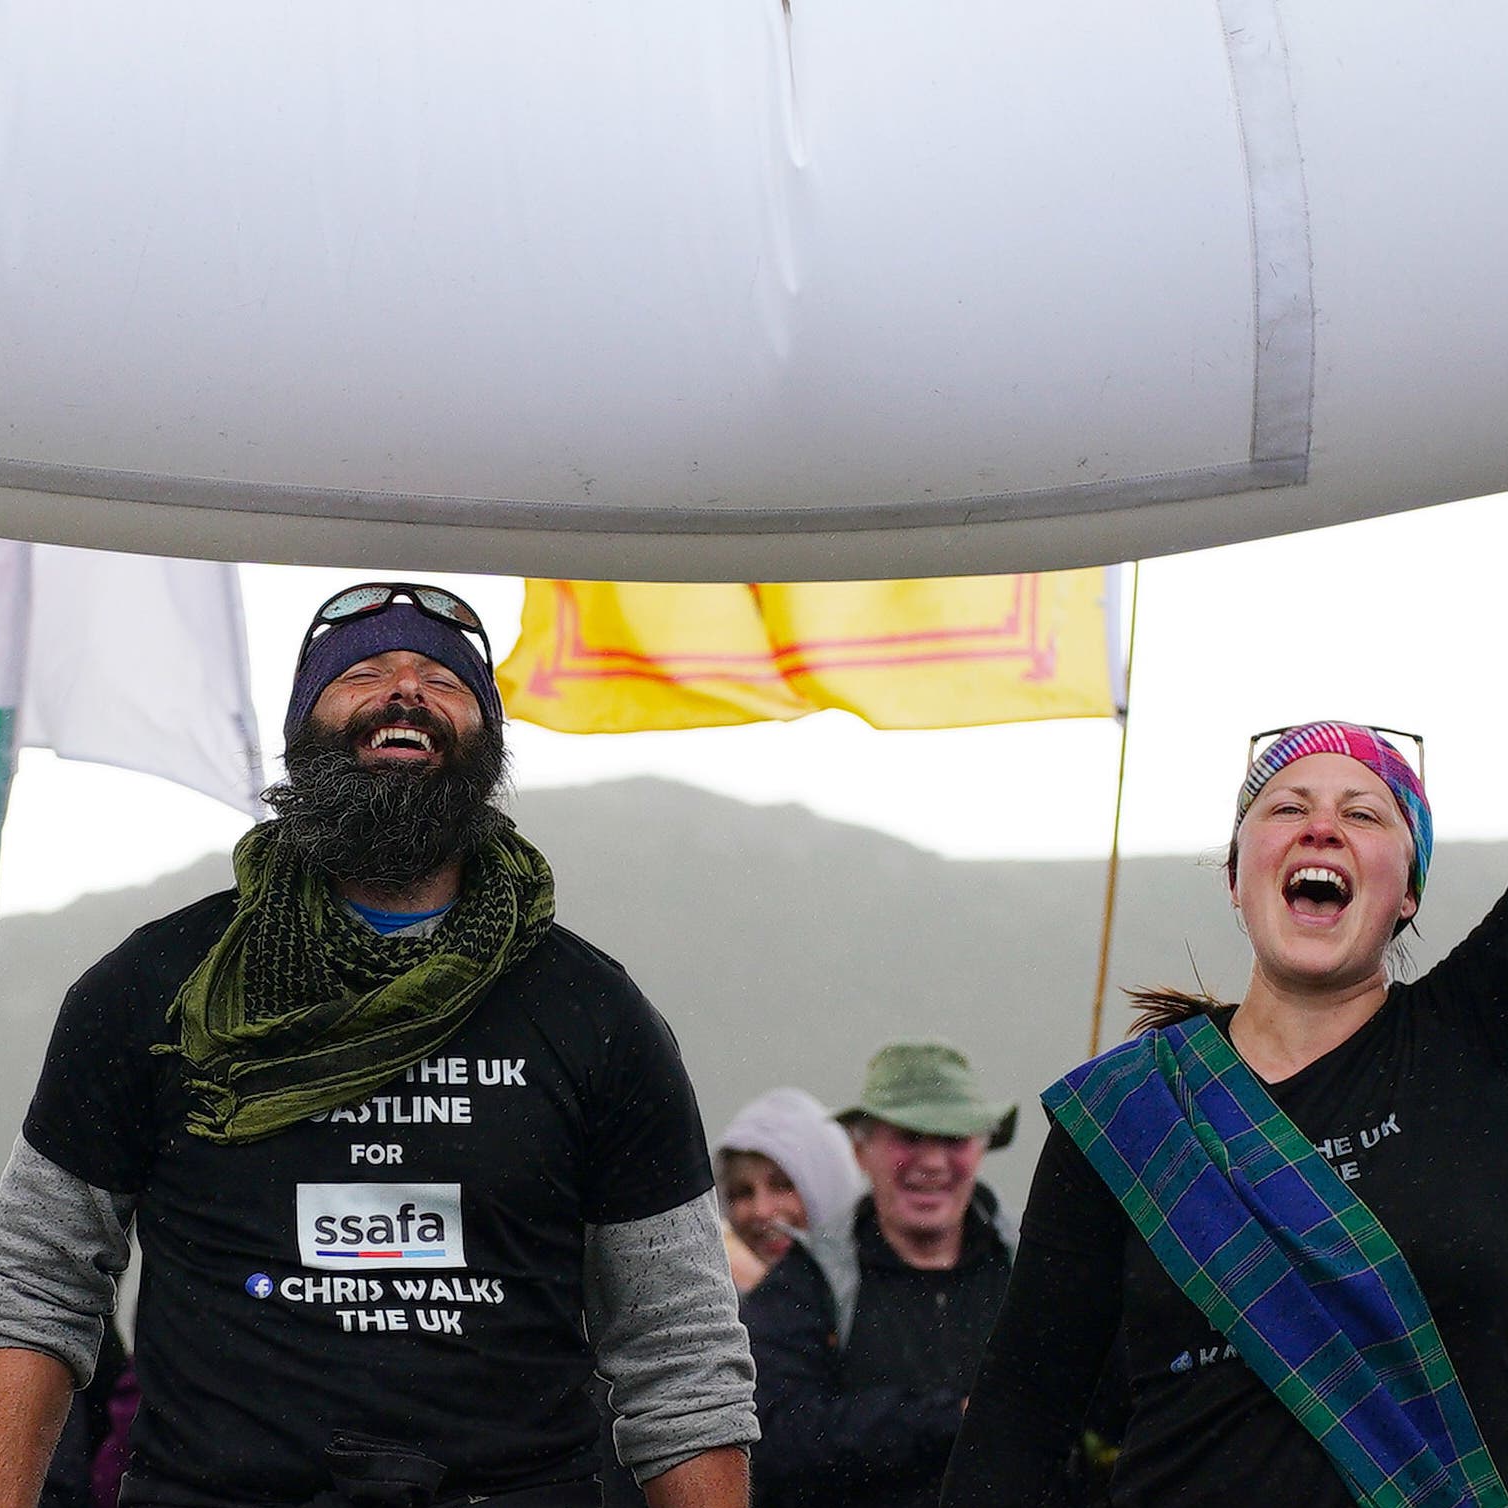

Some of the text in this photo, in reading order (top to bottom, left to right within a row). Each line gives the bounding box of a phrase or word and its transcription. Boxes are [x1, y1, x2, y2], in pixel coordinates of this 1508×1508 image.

[477, 1058, 527, 1087] UK
[309, 1096, 473, 1124] ASTLINE
[1359, 1112, 1402, 1149] UK
[350, 1143, 403, 1165] FOR
[314, 1203, 446, 1246] ssafa
[280, 1276, 381, 1304] CHRIS
[391, 1277, 506, 1305] WALKS
[336, 1309, 464, 1336] THE UK
